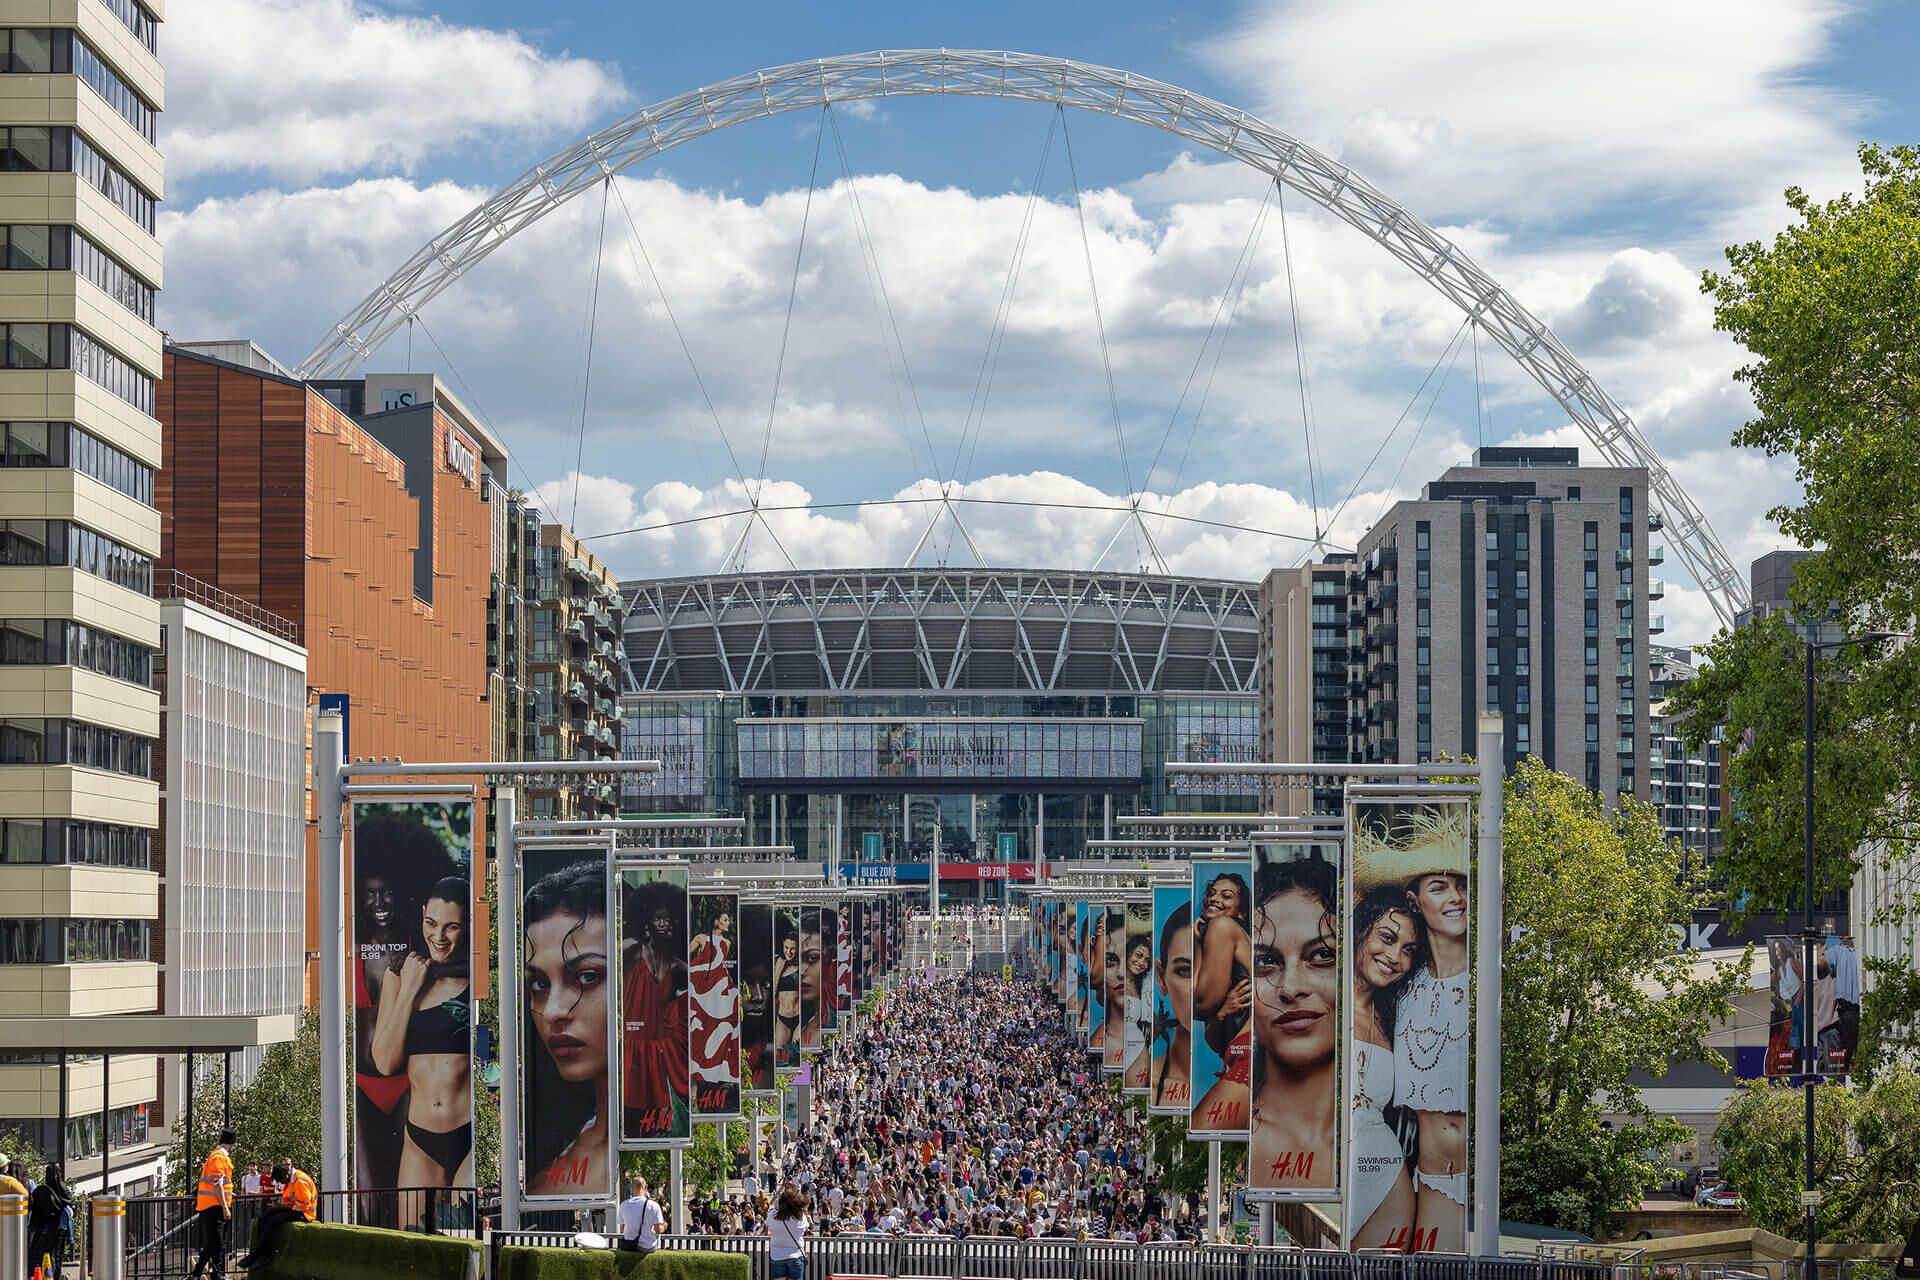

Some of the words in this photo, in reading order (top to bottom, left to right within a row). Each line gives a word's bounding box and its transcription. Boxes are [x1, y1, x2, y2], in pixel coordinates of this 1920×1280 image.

[919, 736, 966, 755] TAYLOR
[967, 736, 1005, 755] SWIFT
[975, 756, 1004, 766] TOUR
[861, 866, 878, 877] BLUE
[978, 866, 992, 877] RED
[640, 1109, 673, 1133] H&M
[1207, 1101, 1241, 1123] H&M
[545, 1156, 589, 1186] H&M
[1271, 1151, 1315, 1180] H&M
[1358, 1157, 1403, 1165] SWIMSUIT
[1379, 1226, 1439, 1256] HM
